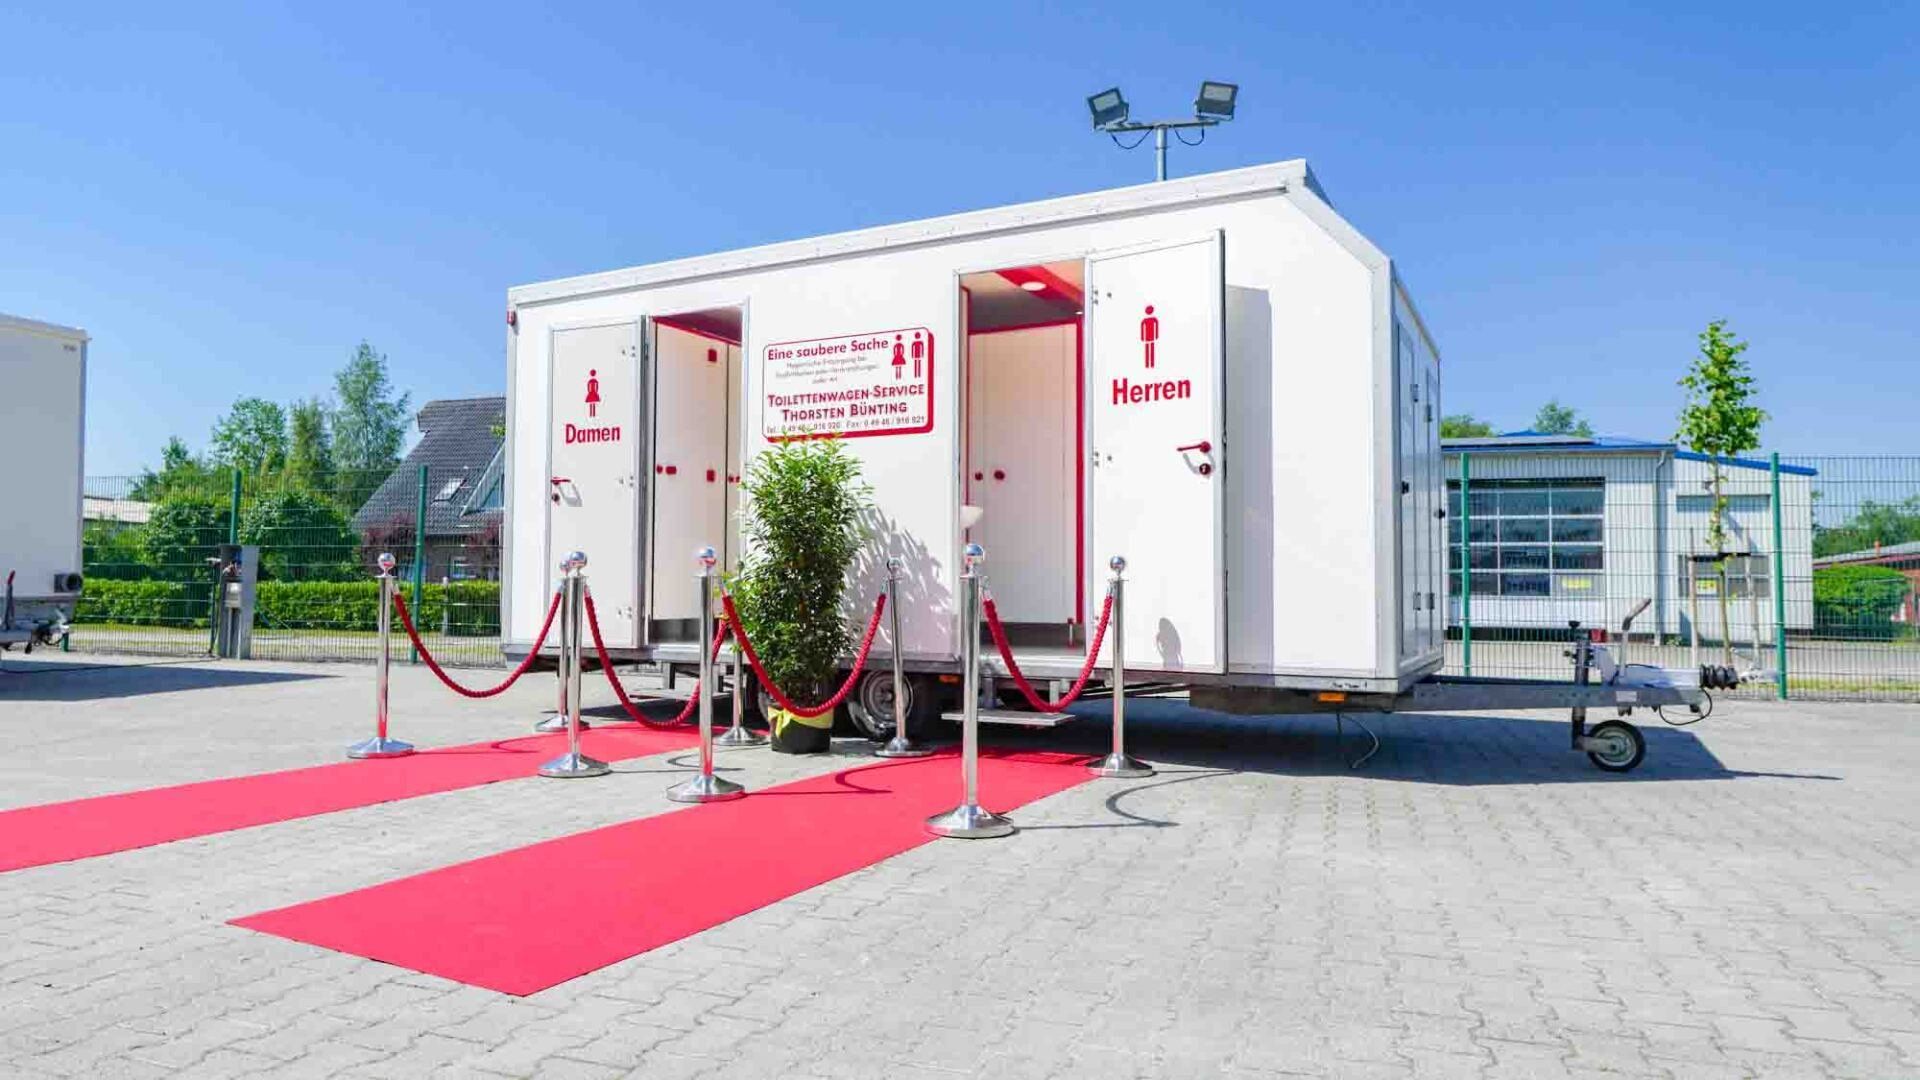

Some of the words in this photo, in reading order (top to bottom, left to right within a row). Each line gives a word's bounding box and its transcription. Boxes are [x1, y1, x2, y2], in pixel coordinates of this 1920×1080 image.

[768, 349, 793, 360] Eine
[797, 343, 847, 357] saubere
[851, 338, 888, 352] Sache
[767, 384, 925, 407] TOILETTENWAGEN-SERVICE
[1113, 378, 1191, 405] Herren
[782, 407, 845, 422] THORSTEN
[850, 402, 907, 416] BÜNTING
[565, 423, 620, 444] Damen
